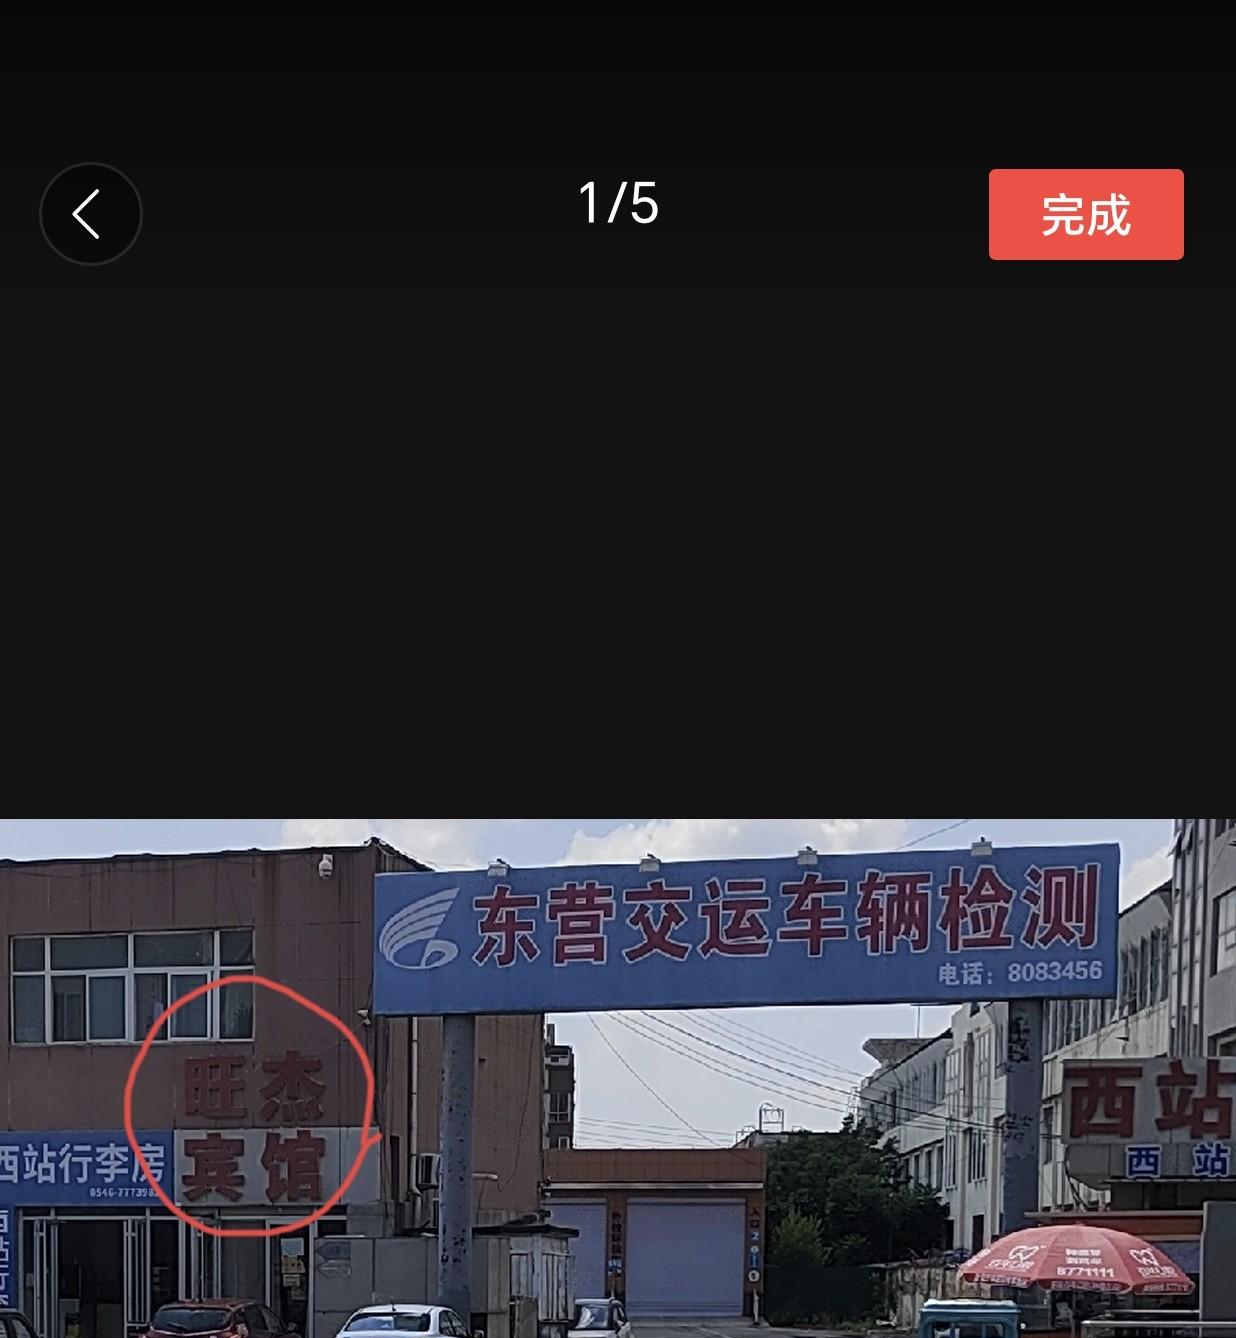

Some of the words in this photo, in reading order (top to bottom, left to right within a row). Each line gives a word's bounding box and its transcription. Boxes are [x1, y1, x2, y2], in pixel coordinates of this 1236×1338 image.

[471, 863, 1101, 967] 东营交运车辆检测
[183, 1050, 326, 1122] 旺杰
[1063, 1058, 1236, 1140] 西站
[0, 1142, 166, 1184] 西站行李房
[181, 1130, 326, 1202] 宾馆
[1126, 1141, 1231, 1178] 西站
